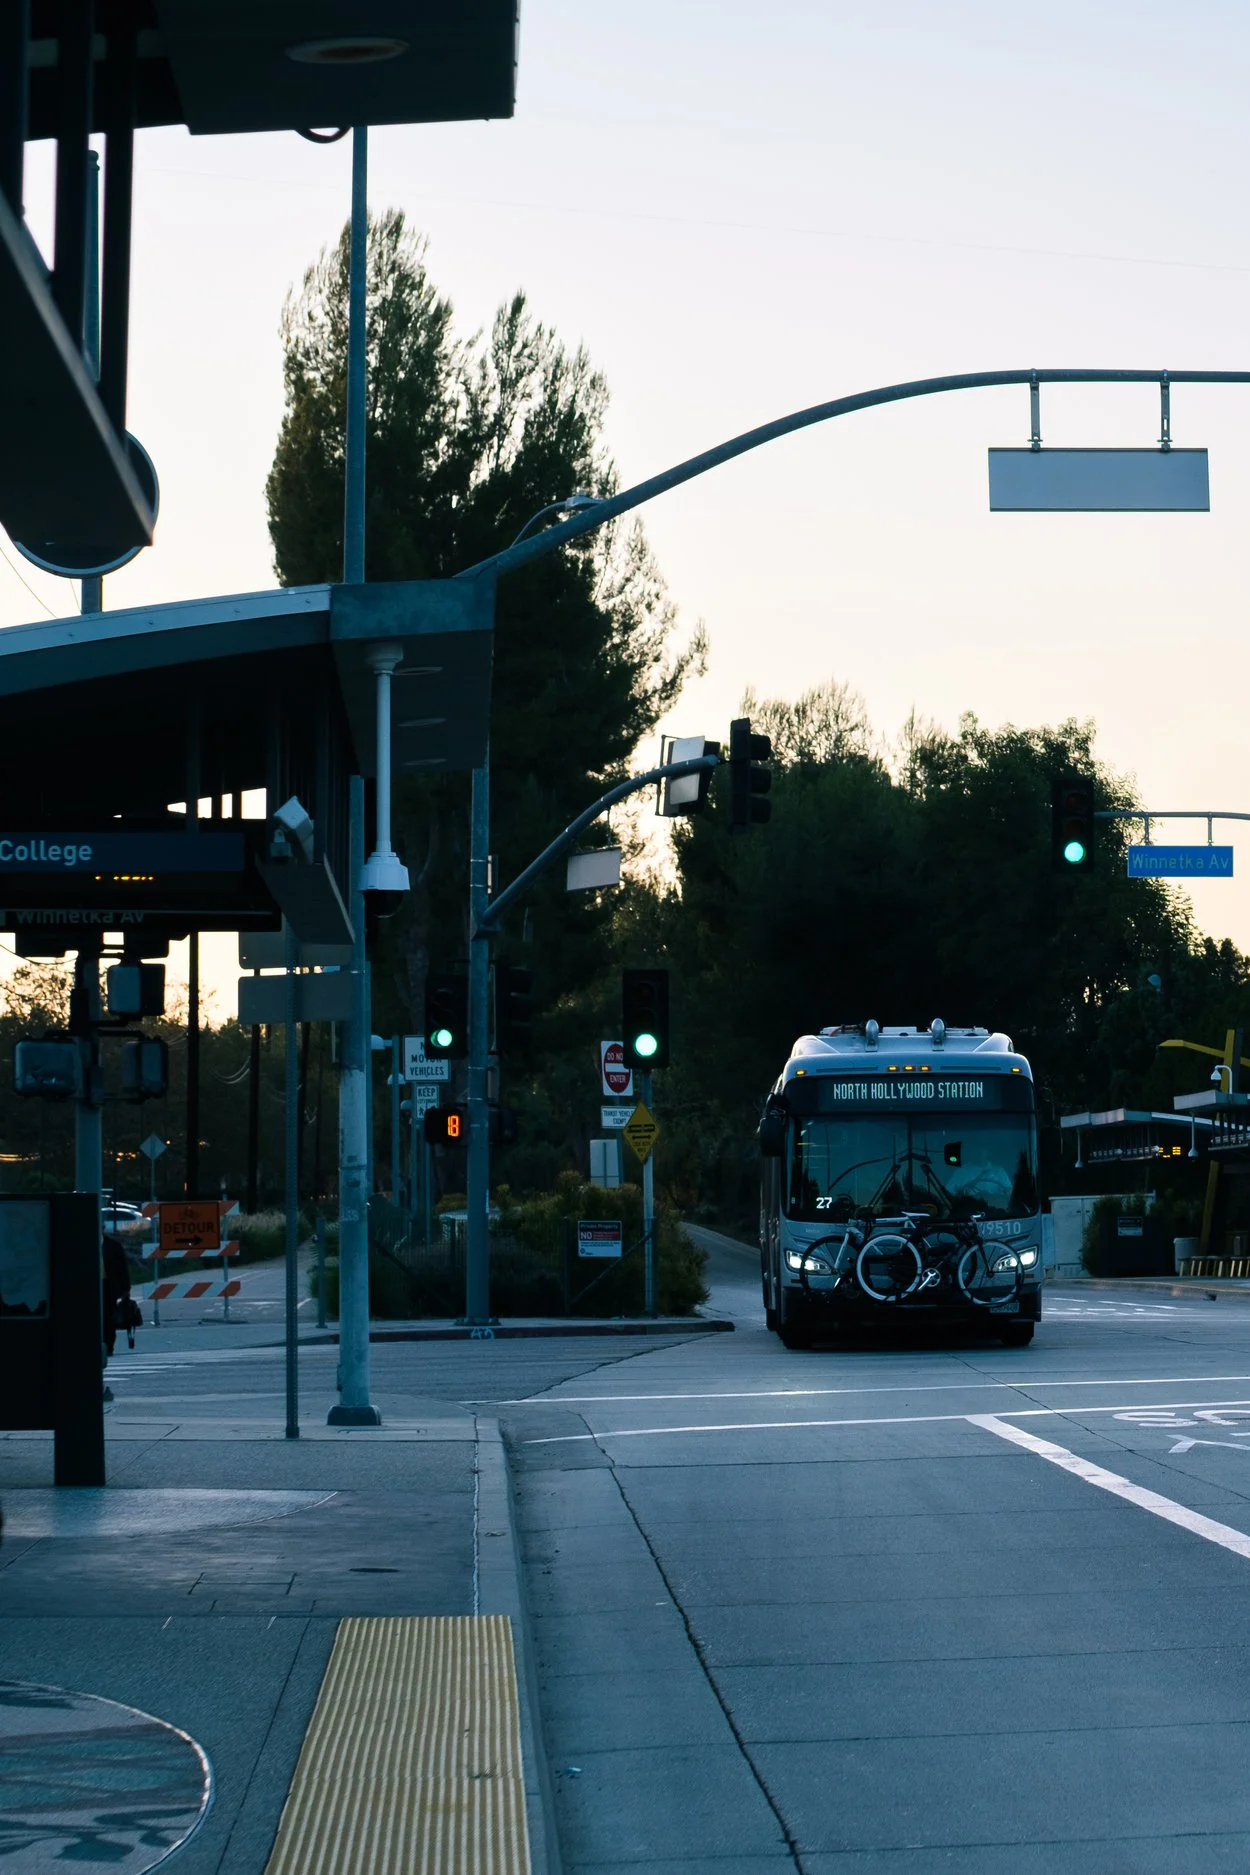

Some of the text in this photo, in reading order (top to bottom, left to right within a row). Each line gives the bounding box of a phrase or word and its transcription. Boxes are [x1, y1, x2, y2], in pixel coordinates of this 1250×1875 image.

[0, 839, 93, 867] College
[1132, 853, 1229, 869] Winnetka Av
[606, 1052, 624, 1061] DO NO
[410, 1066, 444, 1076] VEHICLES
[609, 1074, 627, 1083] ENTER
[418, 1087, 436, 1097] KEEP
[833, 1081, 984, 1100] NORTH HOLLYWOOD STATION
[815, 1196, 832, 1210] 27
[163, 1222, 214, 1234] DETOUR
[580, 1231, 593, 1240] NO
